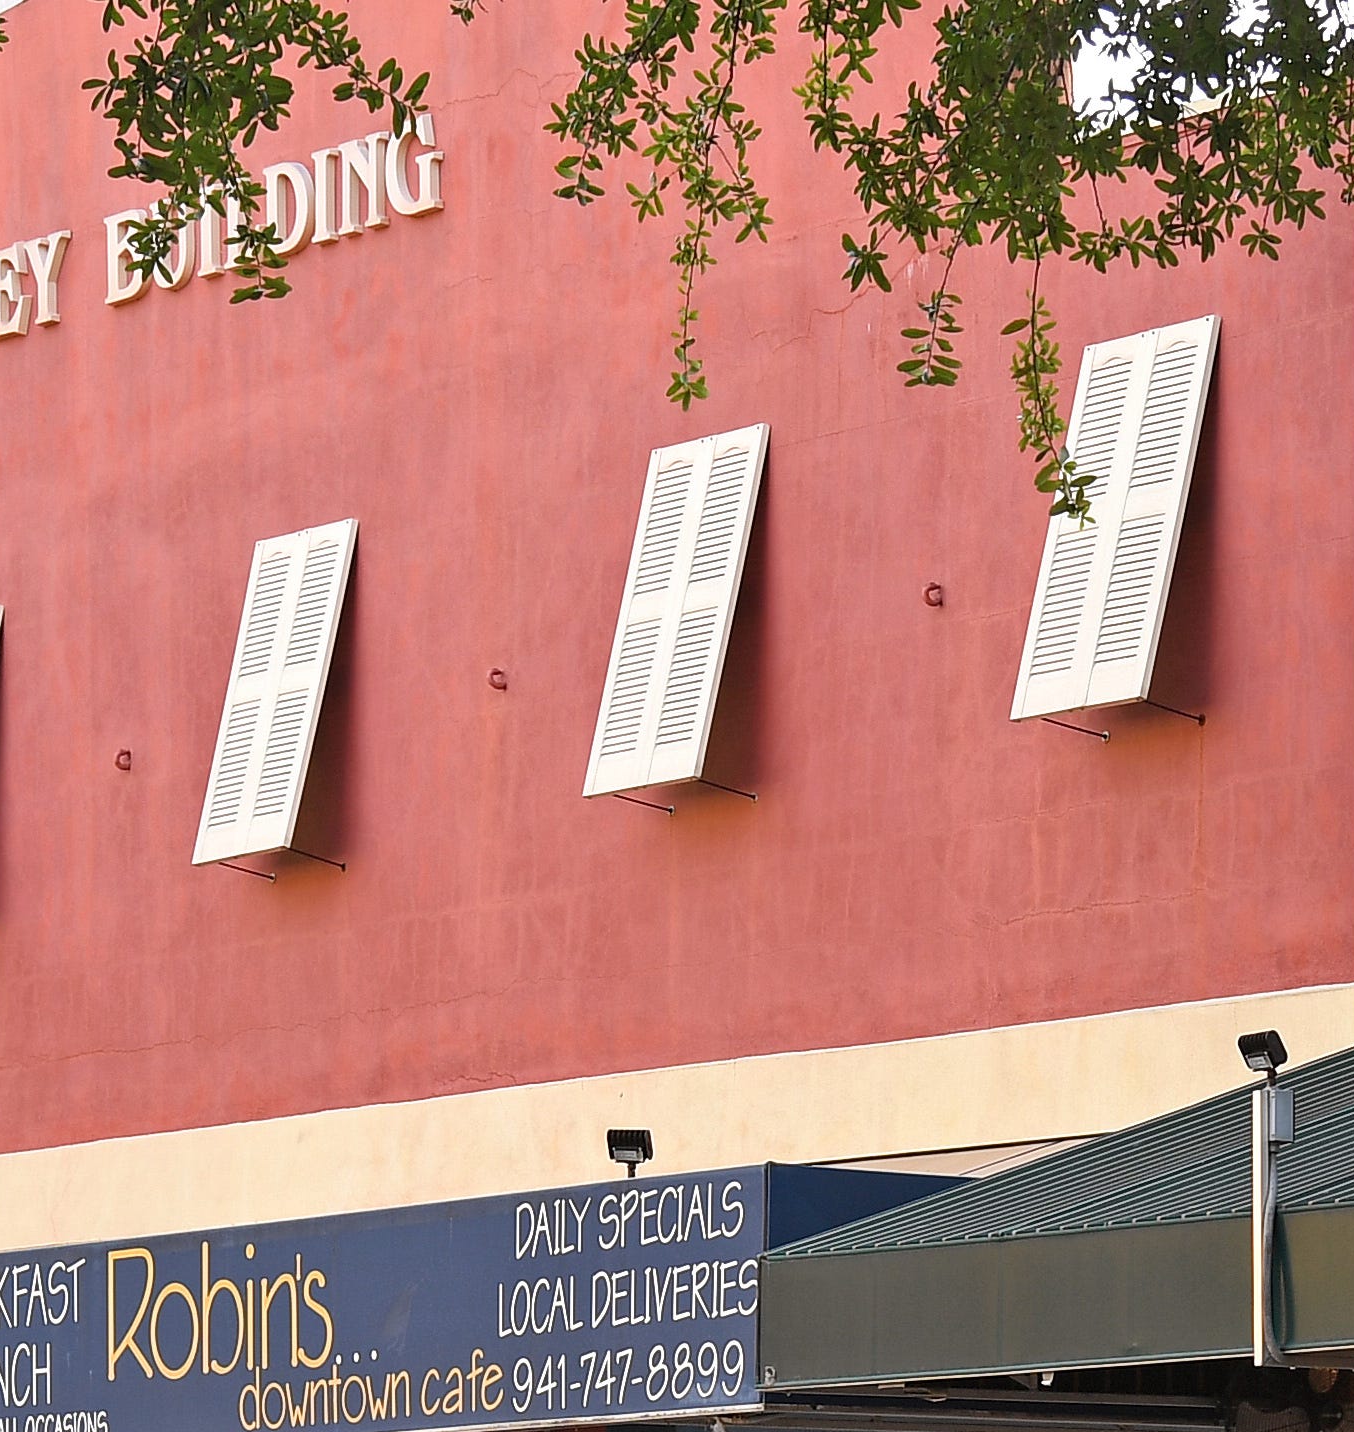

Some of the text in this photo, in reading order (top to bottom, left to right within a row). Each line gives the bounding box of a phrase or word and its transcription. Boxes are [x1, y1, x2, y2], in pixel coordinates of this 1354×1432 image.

[514, 1180, 745, 1261] DAILY SPECIALS
[497, 1258, 760, 1339] LOCAL DELIVERIES
[238, 1348, 506, 1432] downtown cafe
[511, 1338, 746, 1414] 941-747-8899
